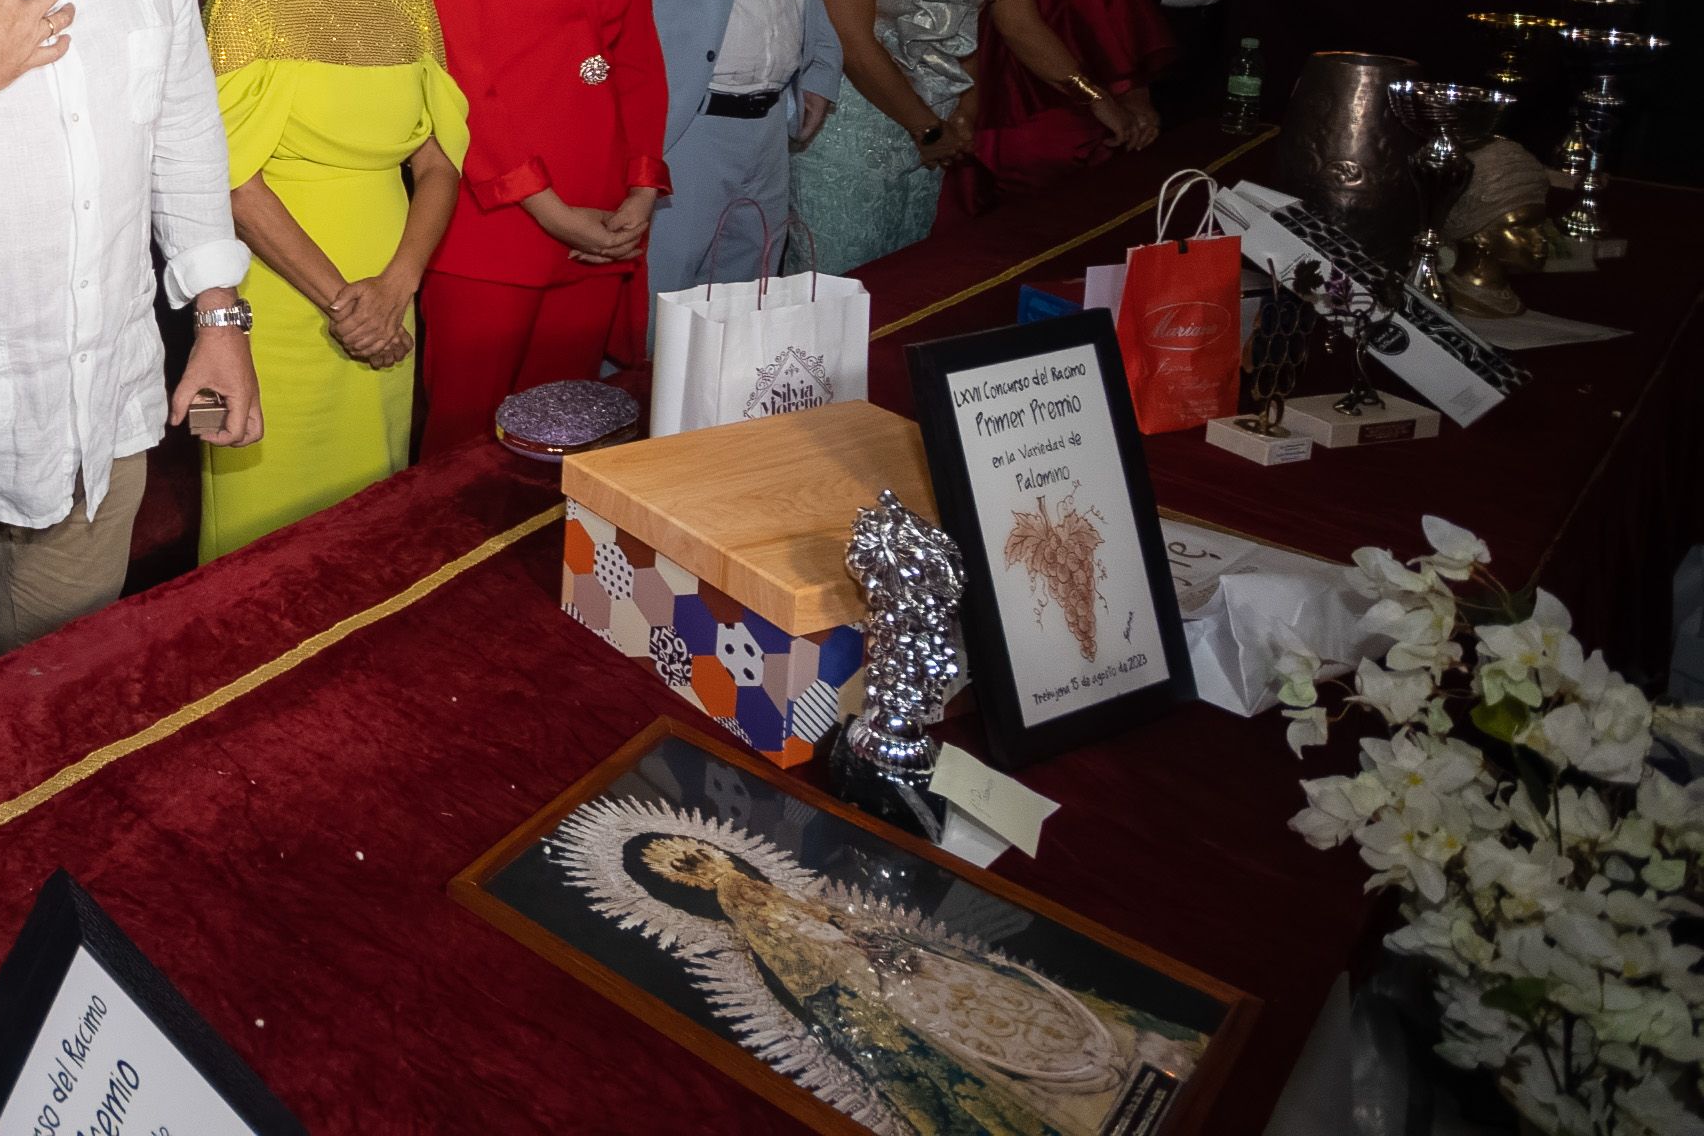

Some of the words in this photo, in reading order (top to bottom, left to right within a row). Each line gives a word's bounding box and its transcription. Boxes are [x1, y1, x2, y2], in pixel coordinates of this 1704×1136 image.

[771, 380, 814, 403] Silvia
[953, 385, 982, 408] LXVII
[983, 376, 1030, 400] Concurso
[1032, 366, 1049, 386] del
[1051, 363, 1086, 382] Racimo
[761, 396, 823, 415] Moreno
[975, 409, 1026, 437] Primer
[1029, 394, 1082, 425] Premio
[992, 455, 1005, 469] en
[1005, 450, 1016, 465] la
[1018, 435, 1066, 459] Variedad
[1068, 431, 1082, 447] de
[1015, 465, 1071, 492] Palomino
[1092, 665, 1116, 686] agosto
[1127, 653, 1148, 671] 2023
[62, 995, 107, 1070] Racimo
[48, 1057, 78, 1103] del
